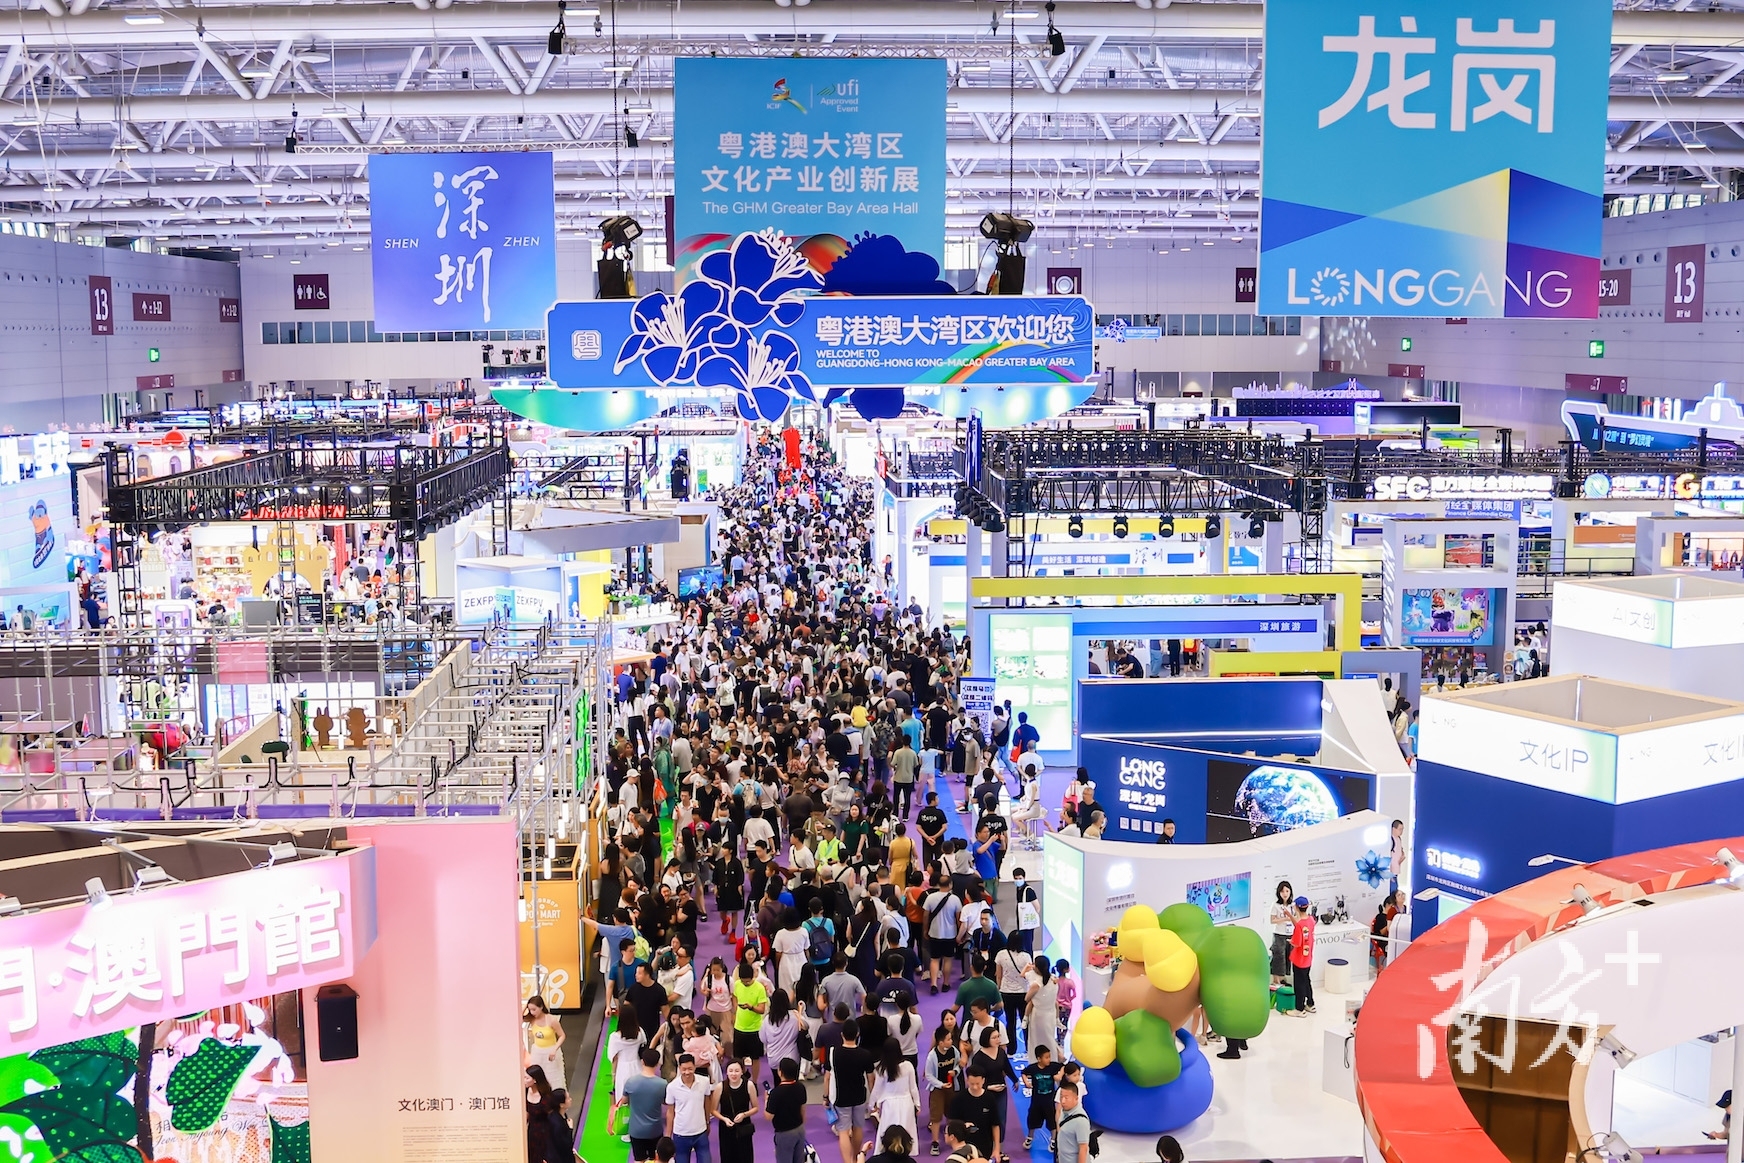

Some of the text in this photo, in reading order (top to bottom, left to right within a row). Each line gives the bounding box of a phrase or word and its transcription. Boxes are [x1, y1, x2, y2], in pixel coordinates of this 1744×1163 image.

[1318, 15, 1556, 134] 龙岗
[837, 79, 859, 96] ufi
[717, 131, 904, 159] 粤港澳大湾区
[701, 165, 920, 193] 文化产业创新展
[702, 201, 919, 217] The GHM Greater Bay Area Hall
[384, 238, 420, 249] SHEN
[433, 165, 500, 323] 深圳
[503, 236, 540, 247] ZHEN
[1288, 267, 1573, 308] LONGGANG
[1673, 261, 1697, 304] 13
[94, 288, 109, 321] 13
[815, 314, 1075, 346] 粤港澳大湾区欢迎您
[816, 349, 880, 358] WELCOME TO
[984, 357, 1028, 367] GREATER
[1029, 357, 1048, 367] BAY
[1049, 357, 1075, 367] AREA
[1374, 476, 1430, 500] SFC
[1042, 556, 1072, 564] 美好生活
[464, 595, 495, 608] ZEXFP
[1259, 621, 1301, 632] 深圳旅游
[1519, 739, 1589, 773] 文化IP
[1703, 735, 1744, 766] 文化I
[1121, 756, 1166, 776] LONG
[1119, 769, 1166, 790] GANG
[540, 910, 561, 919] MART
